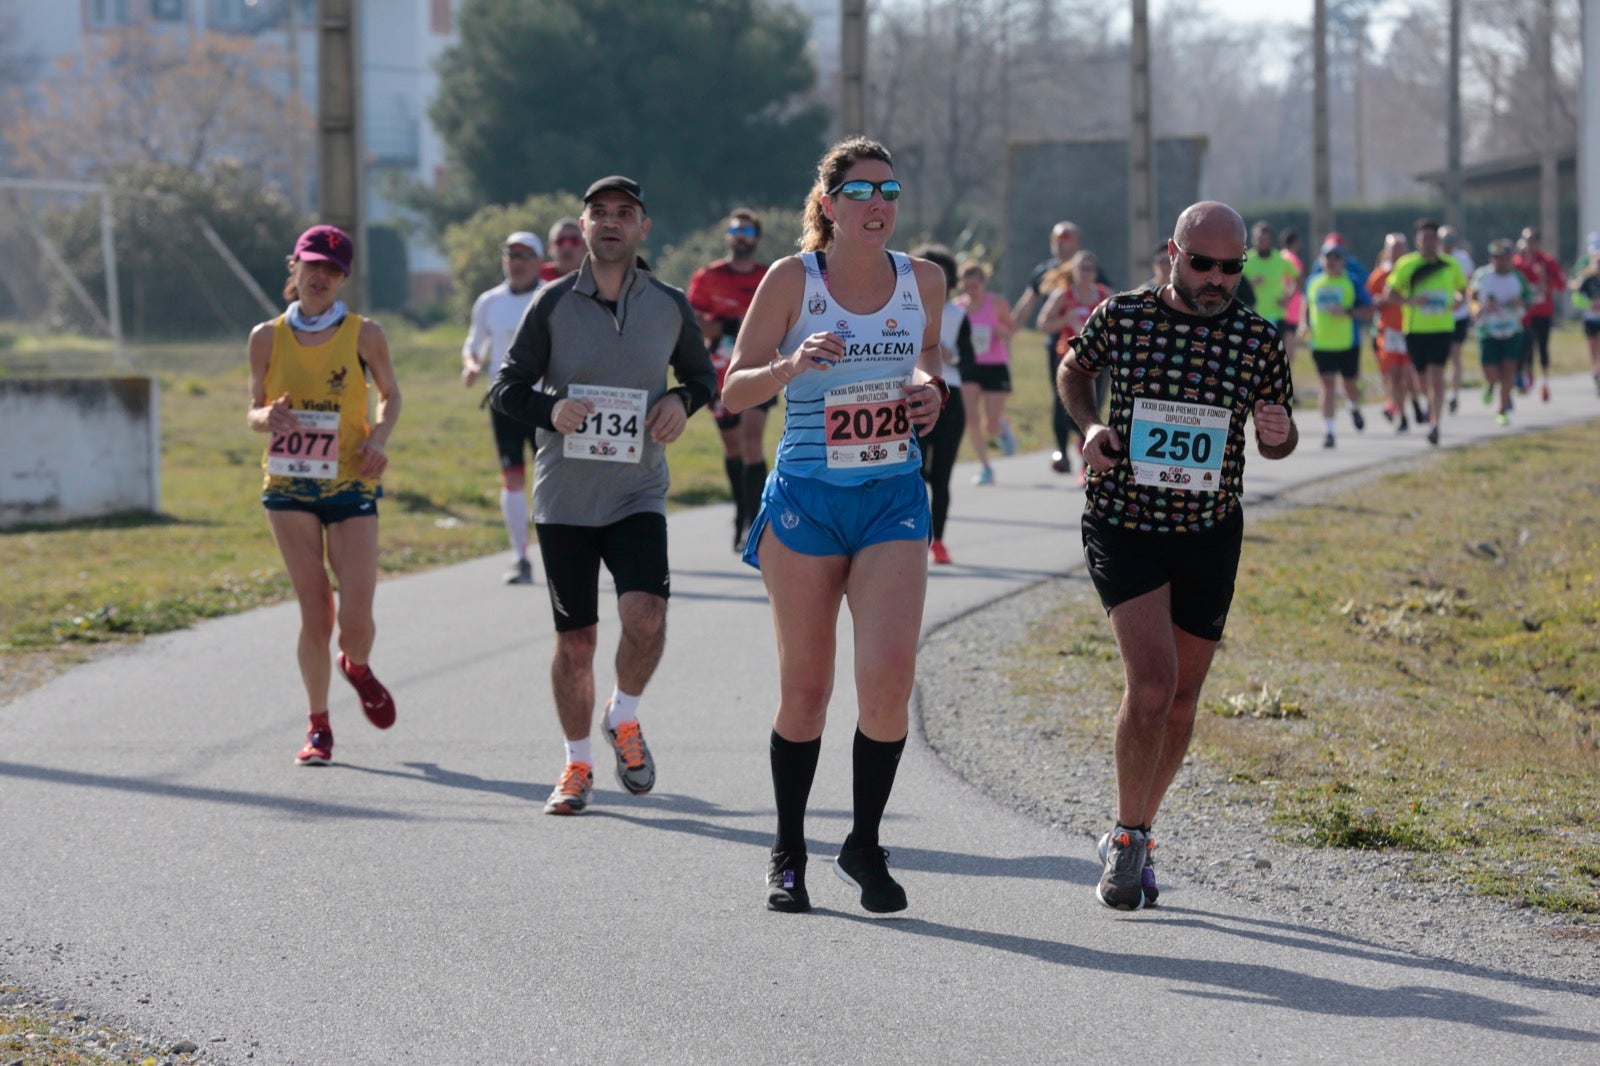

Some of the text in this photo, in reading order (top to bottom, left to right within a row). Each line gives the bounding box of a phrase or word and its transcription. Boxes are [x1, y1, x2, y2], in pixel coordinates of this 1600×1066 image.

[848, 384, 864, 395] GRAN
[864, 382, 885, 393] PREMIO
[1158, 403, 1175, 414] GRAN
[1175, 405, 1198, 416] PREMIO
[1198, 407, 1207, 417] DE
[1206, 409, 1227, 419] FONDO
[1165, 413, 1201, 426] DIPUTACIÓN
[831, 404, 909, 440] 2028
[271, 431, 335, 457] 2077
[1145, 427, 1211, 464] 250
